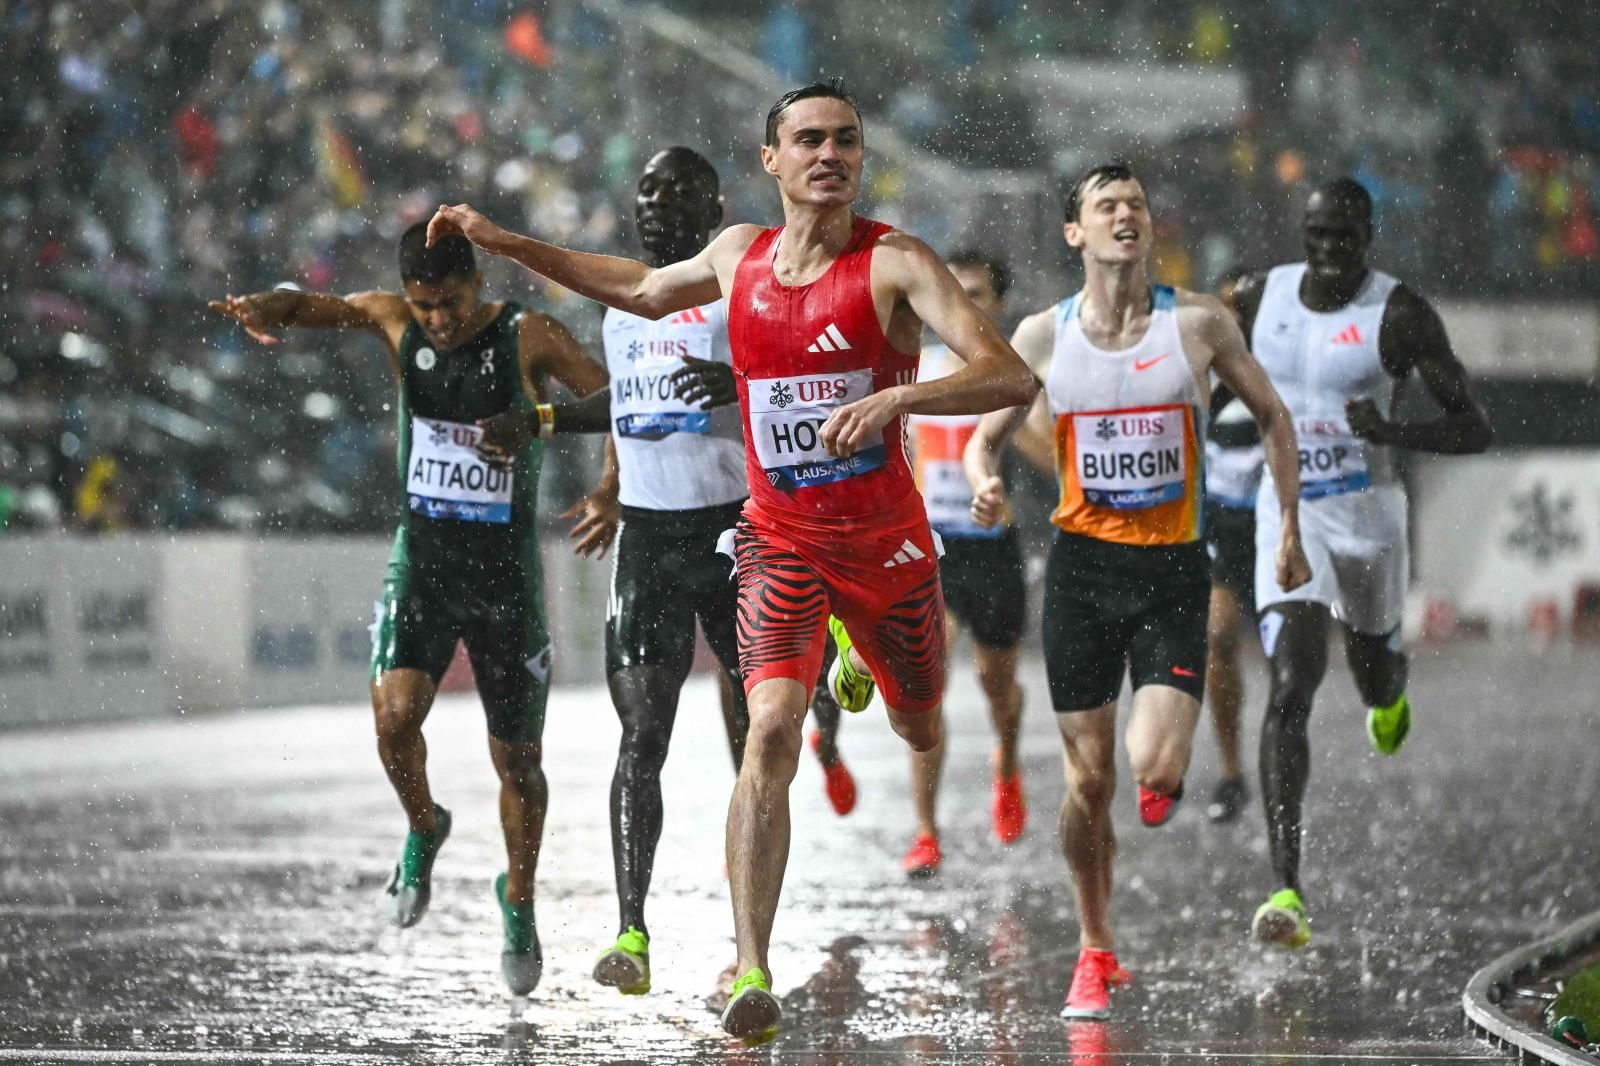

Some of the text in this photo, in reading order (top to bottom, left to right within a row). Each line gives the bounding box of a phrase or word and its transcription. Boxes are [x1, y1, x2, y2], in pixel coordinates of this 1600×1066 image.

[797, 379, 848, 402] UBS
[453, 427, 479, 448] UB
[771, 418, 828, 454] HO
[1121, 418, 1165, 437] UBS
[794, 456, 862, 481] LAUSANNE
[1083, 446, 1180, 480] BURGIN
[1298, 446, 1347, 473] ROP
[412, 456, 508, 493] ATTAOUI
